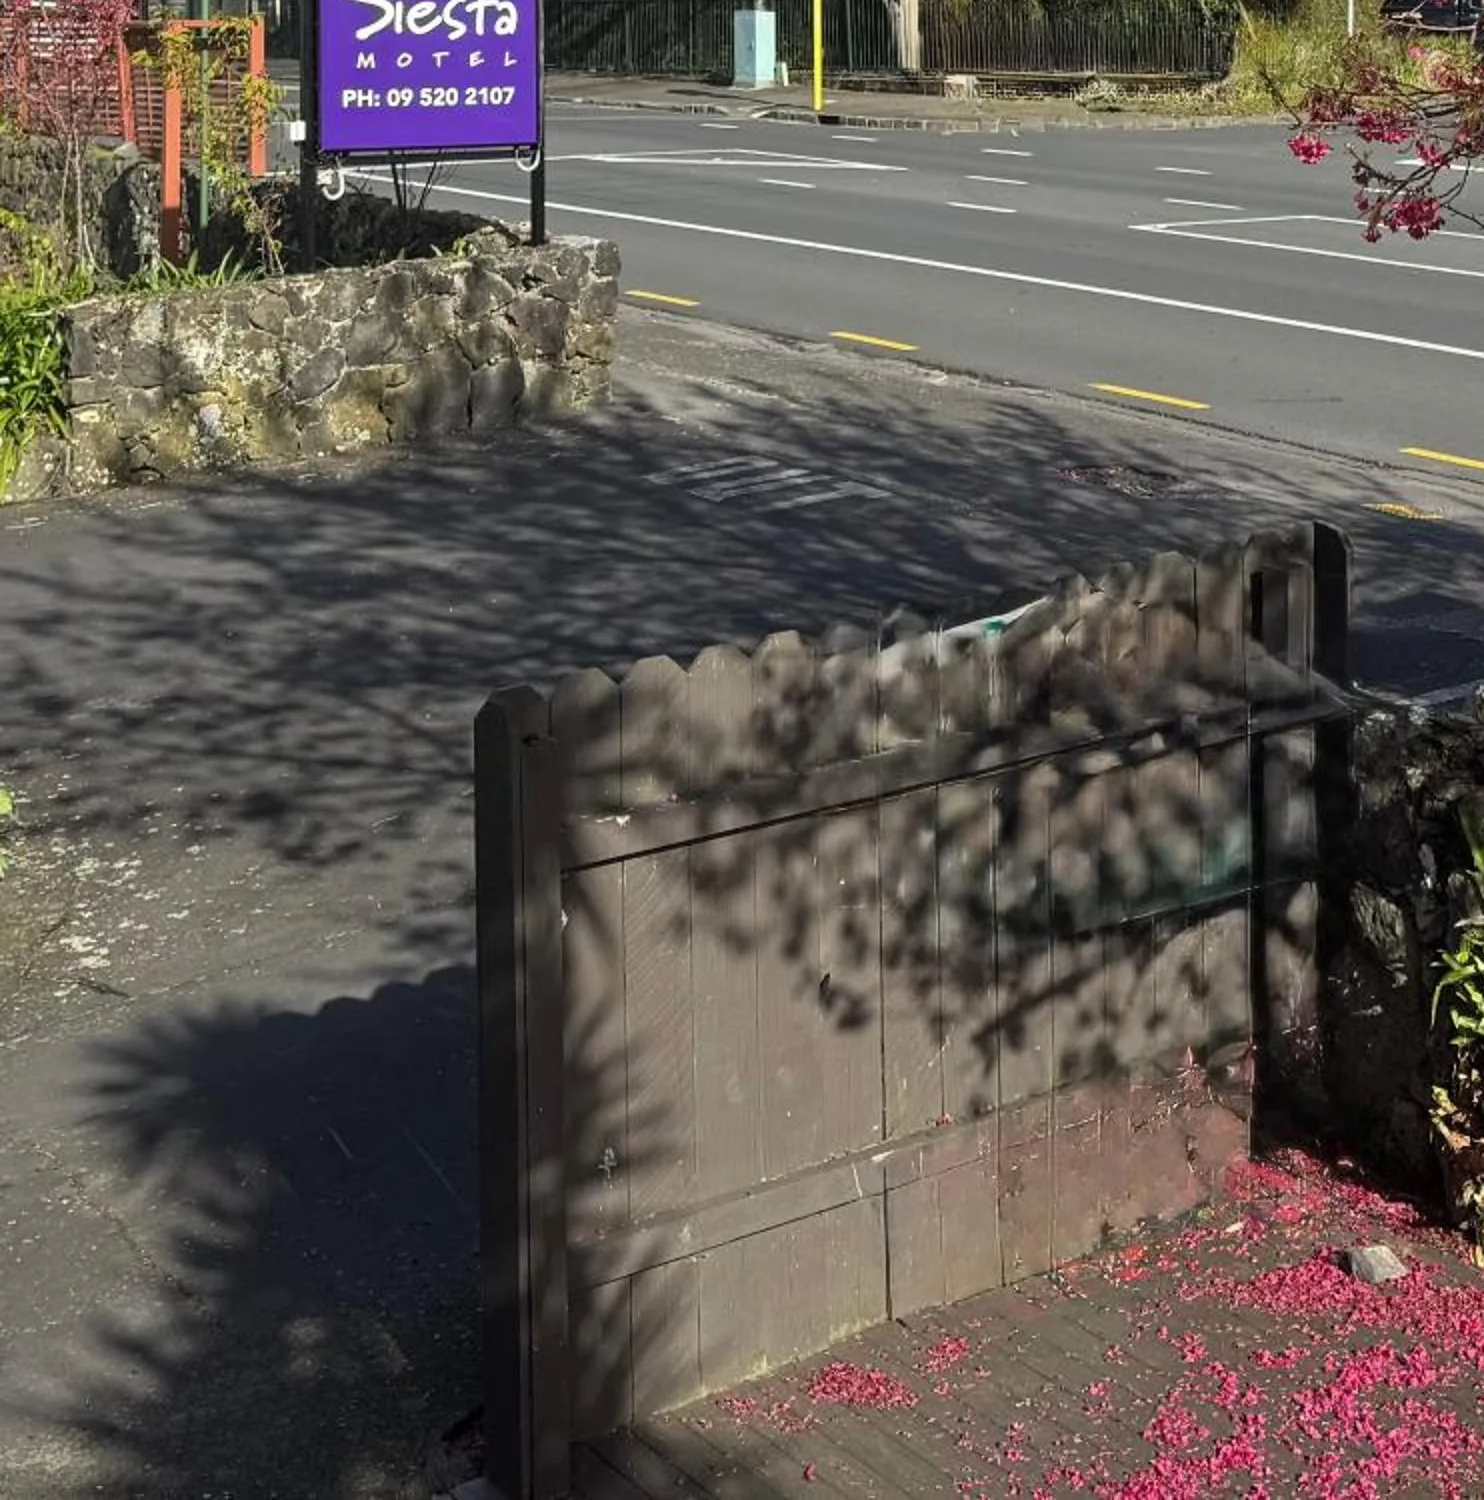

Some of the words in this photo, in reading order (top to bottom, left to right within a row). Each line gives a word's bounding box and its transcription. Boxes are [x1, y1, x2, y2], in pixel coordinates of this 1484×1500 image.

[355, 51, 518, 69] MOTEL
[342, 89, 381, 108] PH:
[386, 88, 414, 107] 09
[419, 87, 459, 107] 520
[464, 86, 516, 106] 2107
